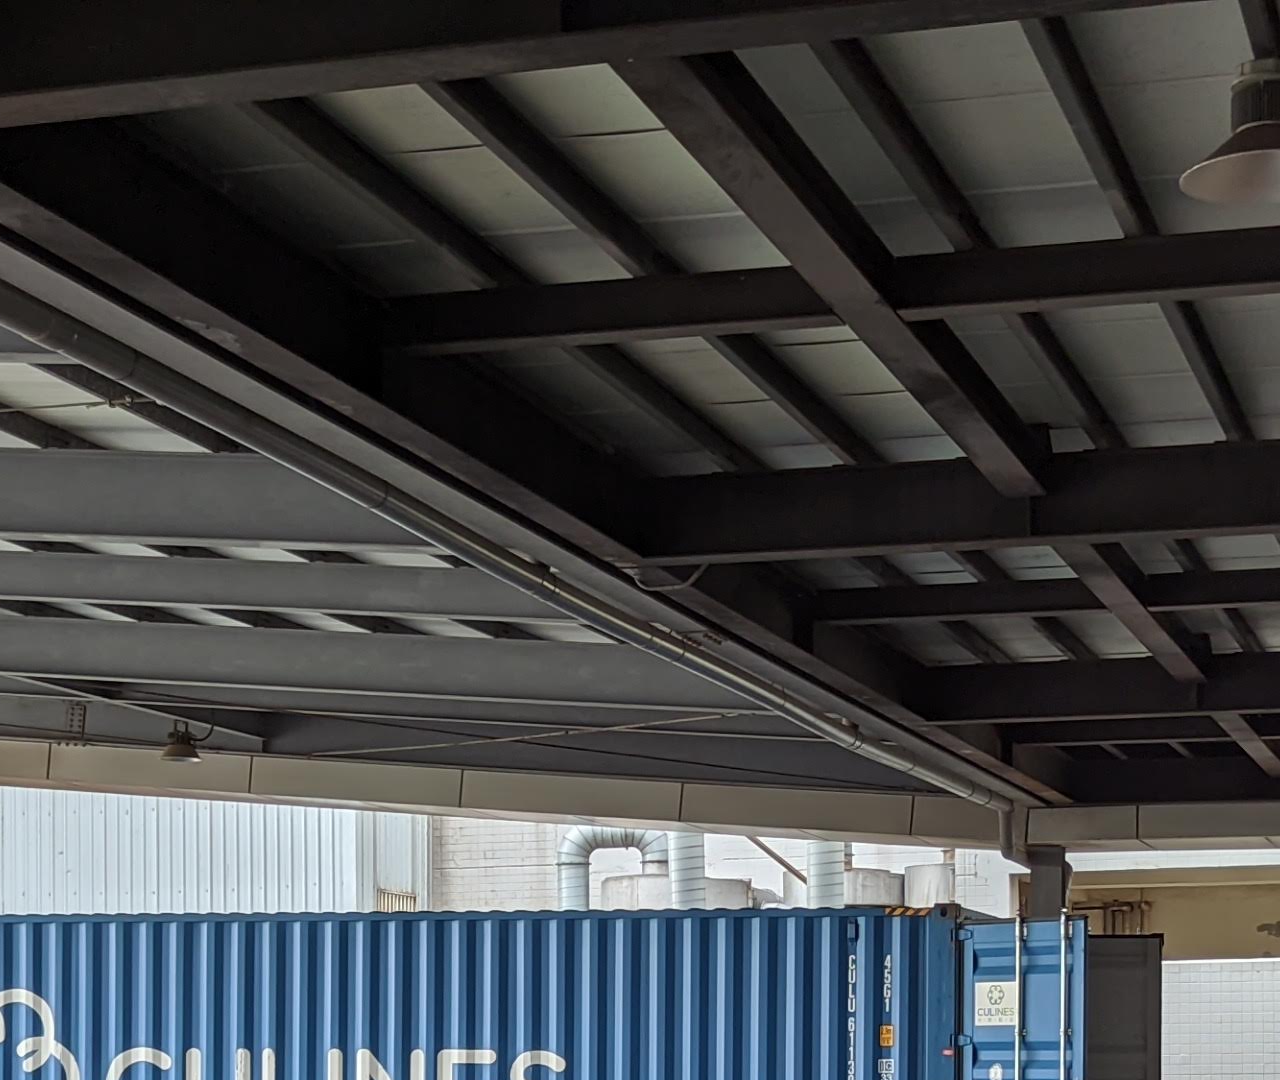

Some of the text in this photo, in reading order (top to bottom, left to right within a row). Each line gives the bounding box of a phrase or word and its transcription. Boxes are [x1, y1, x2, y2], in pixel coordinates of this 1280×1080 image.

[847, 954, 857, 1013] CULU
[883, 954, 892, 1013] 45G1
[977, 1007, 1015, 1017] CULINES
